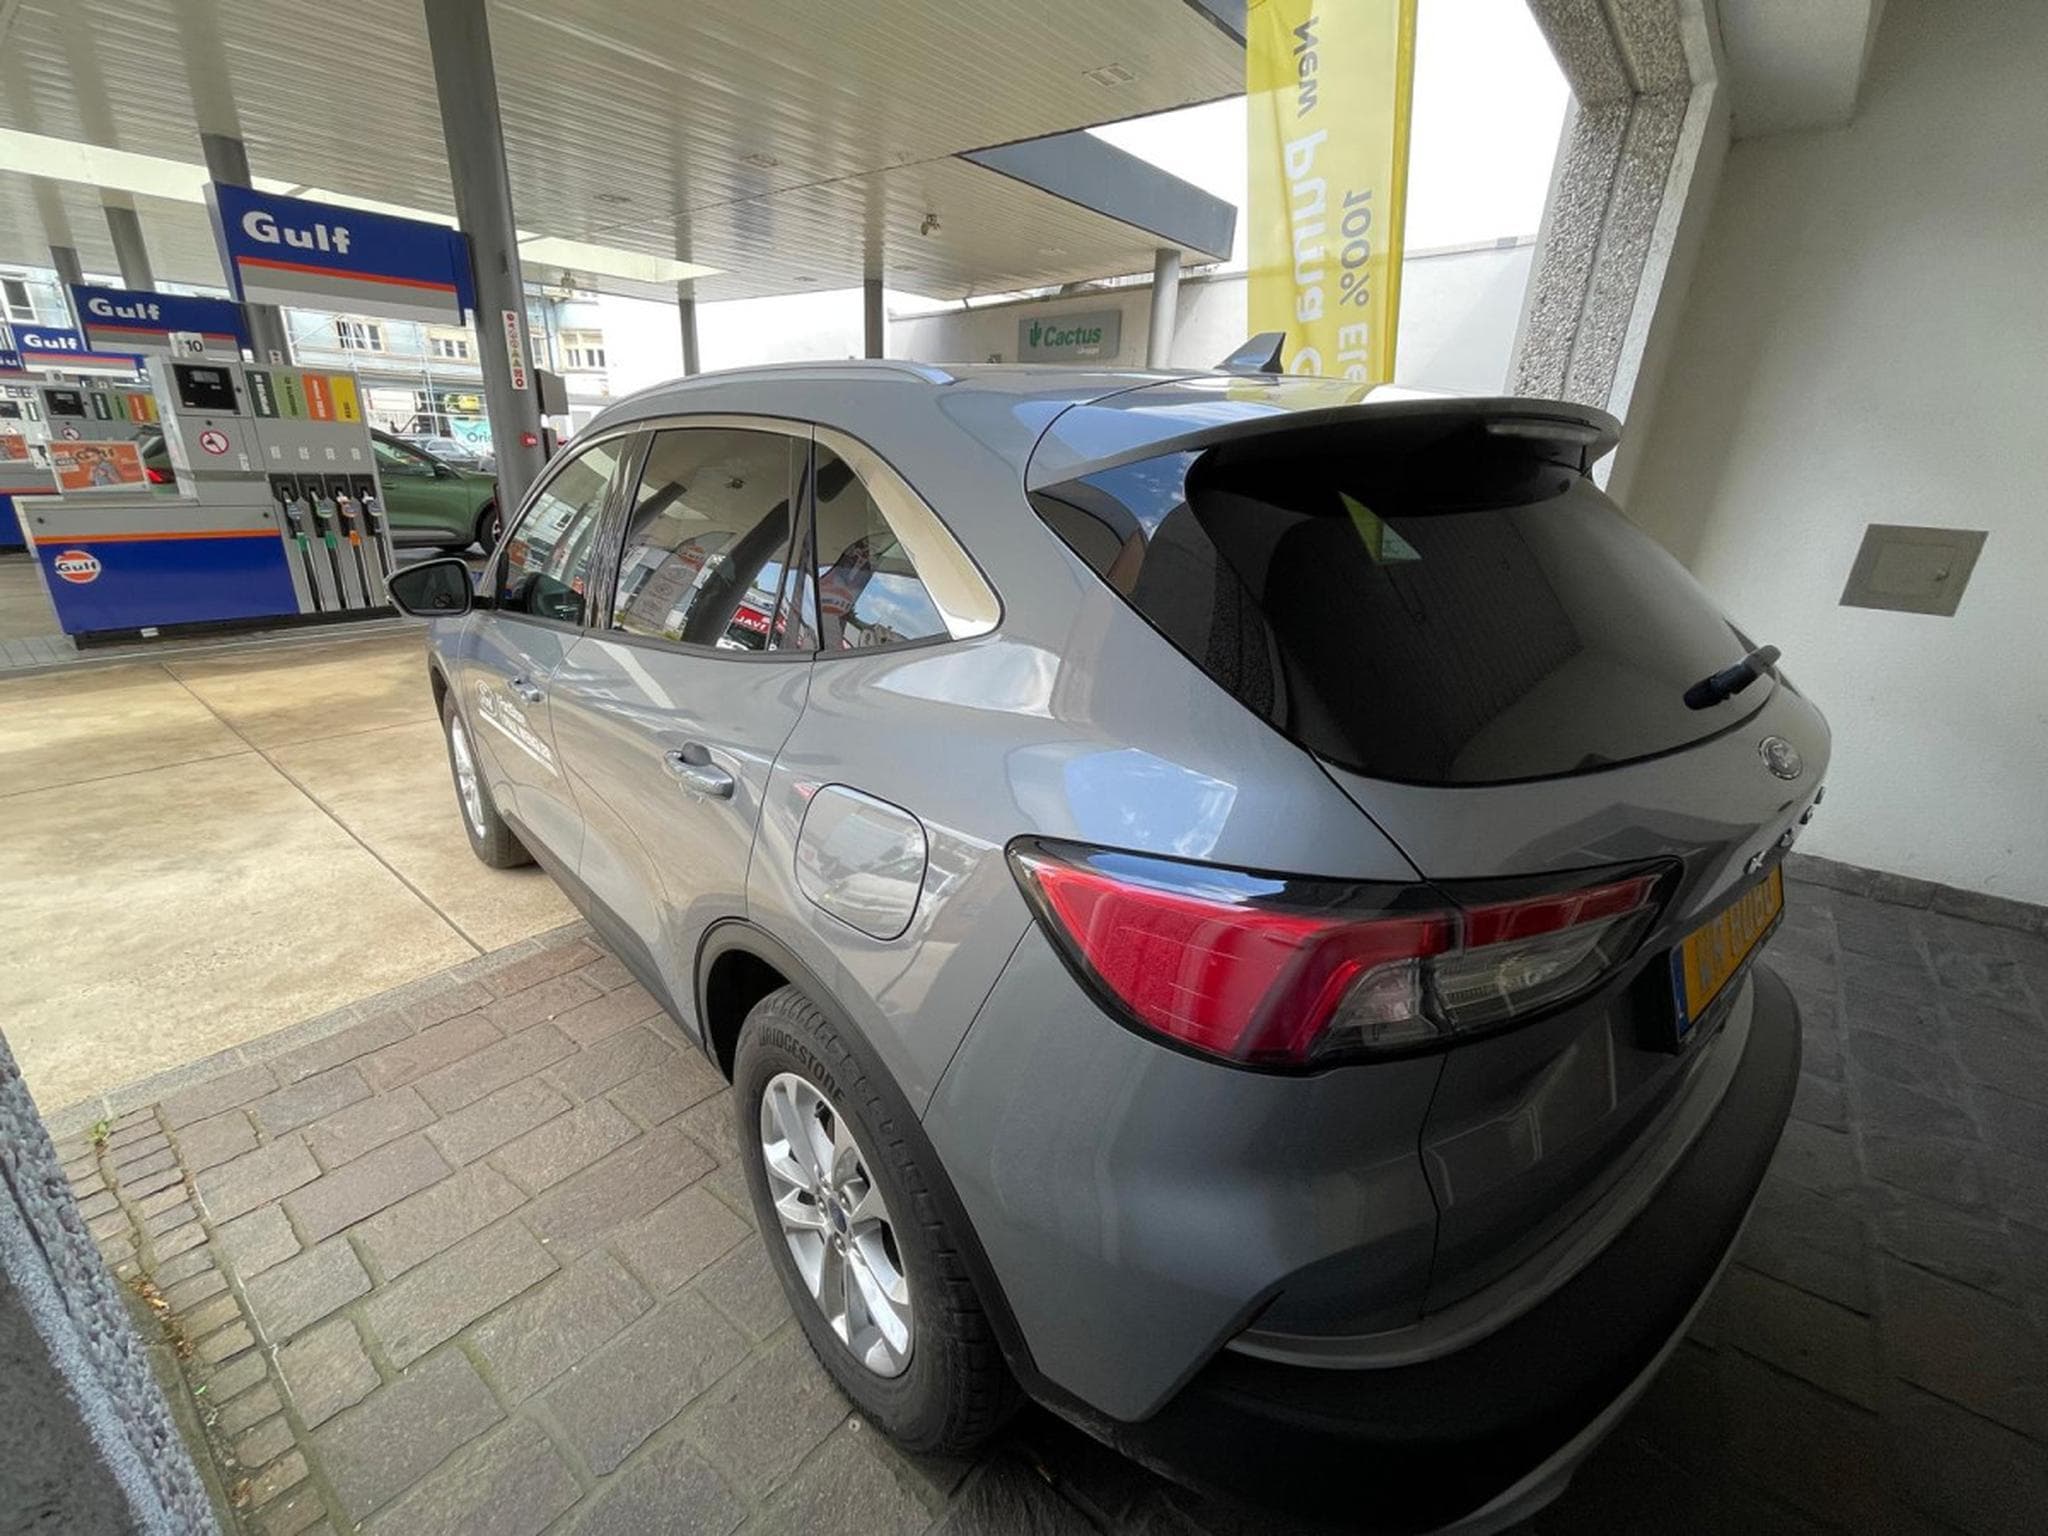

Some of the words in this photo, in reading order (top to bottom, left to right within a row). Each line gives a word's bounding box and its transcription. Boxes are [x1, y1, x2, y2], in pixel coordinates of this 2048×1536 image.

[242, 210, 350, 254] Gulf
[88, 297, 160, 321] Gulf
[23, 333, 78, 350] Gulf
[185, 339, 203, 352] 10
[1043, 325, 1102, 347] Cactus
[58, 561, 97, 572] Gulf
